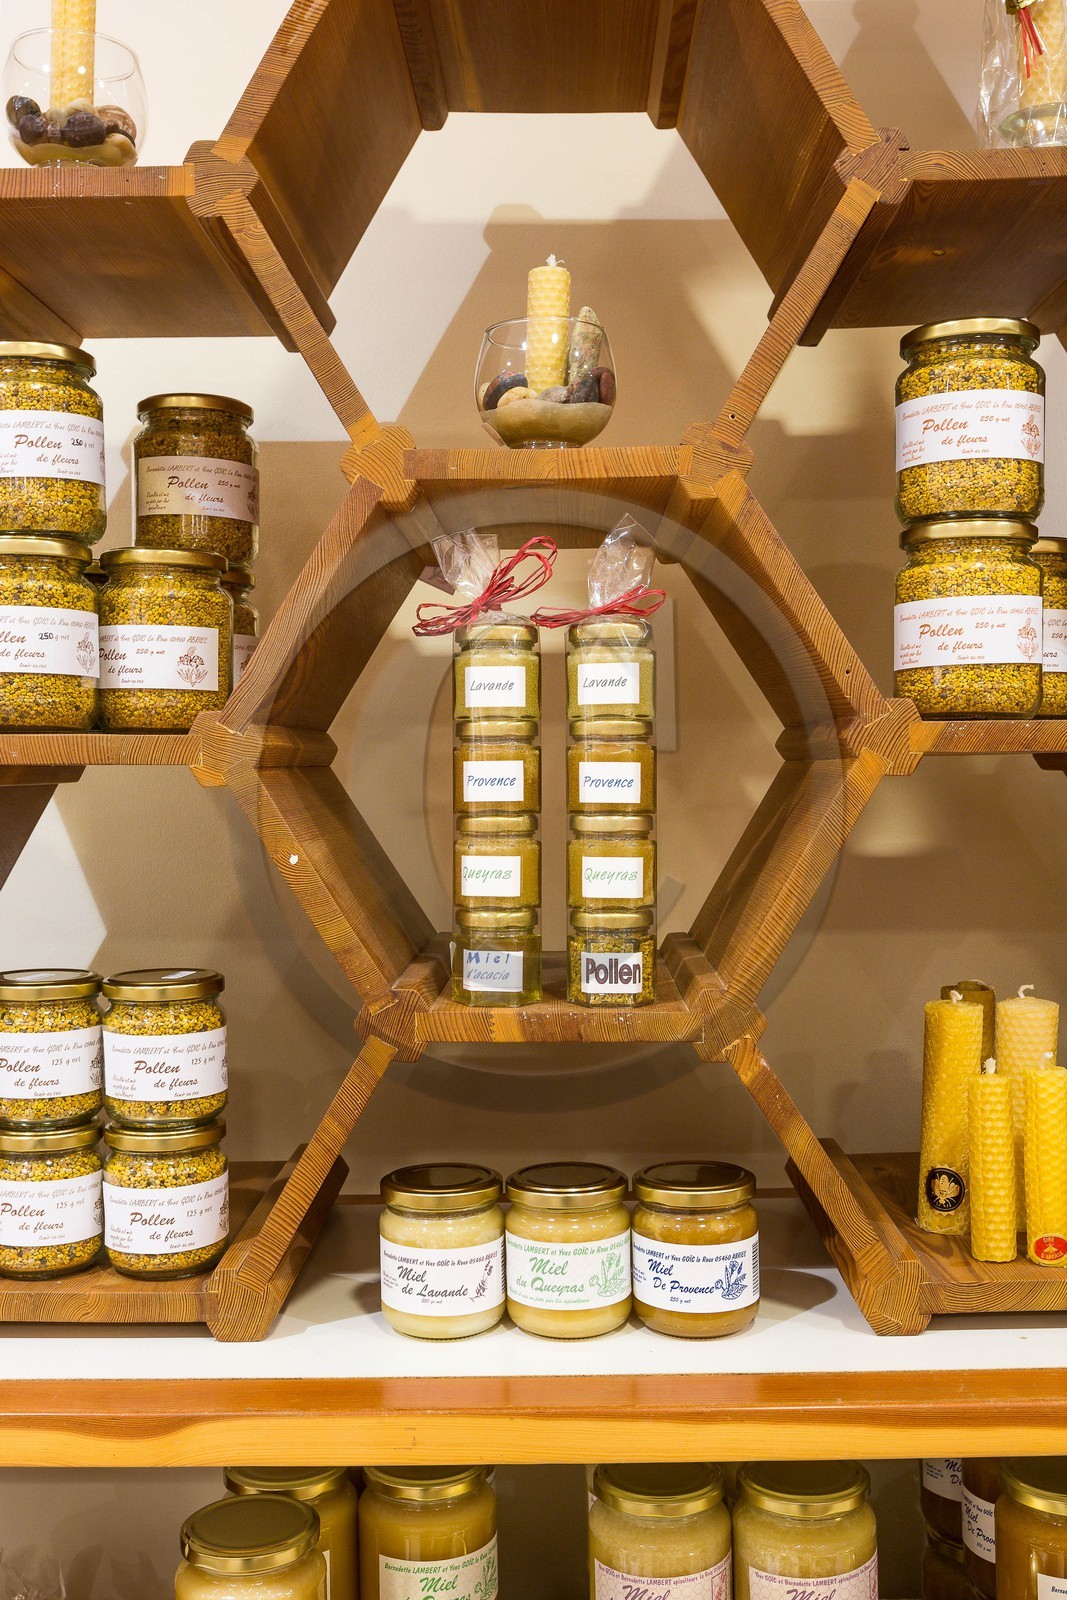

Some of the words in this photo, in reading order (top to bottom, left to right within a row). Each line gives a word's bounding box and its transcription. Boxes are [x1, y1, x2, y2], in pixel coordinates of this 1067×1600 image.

[922, 402, 953, 415] LAMBERT
[922, 418, 968, 435] Pollen
[14, 434, 62, 449] Pollen
[71, 438, 83, 446] 250
[941, 435, 952, 445] de
[956, 435, 988, 447] fleurs
[37, 454, 48, 462] de
[52, 455, 79, 465] fleurs
[167, 476, 209, 489] Pollen
[198, 494, 224, 503] fleurs
[918, 609, 947, 619] LAMBERT
[38, 632, 54, 640] 250
[918, 623, 964, 640] Pollen
[937, 642, 949, 651] de
[952, 641, 984, 653] fleurs
[0, 649, 11, 657] de
[14, 649, 46, 660] fleurs
[118, 665, 143, 676] fleurs
[470, 680, 514, 691] Lavande
[582, 676, 628, 688] Lavande
[467, 775, 517, 787] Provence
[583, 775, 634, 789] Provence
[463, 866, 513, 883] Queyras
[584, 867, 638, 884] Queyras
[466, 952, 510, 964] Miel
[467, 969, 510, 981] d'acacia
[585, 958, 641, 985] Pollen
[133, 1046, 165, 1055] LAMBERT
[133, 1060, 181, 1074] Pollen
[191, 1057, 201, 1066] 125
[14, 1078, 26, 1086] de
[29, 1078, 60, 1089] fleurs
[154, 1080, 166, 1088] de
[169, 1078, 198, 1090] fleurs
[0, 1202, 45, 1216] Pollen
[129, 1199, 160, 1207] LAMBERT
[130, 1212, 176, 1226] Pollen
[186, 1210, 197, 1218] 125
[205, 1205, 213, 1214] net
[19, 1222, 30, 1230] de
[33, 1222, 64, 1233] fleurs
[149, 1231, 161, 1240] de
[164, 1229, 194, 1242] fleurs
[523, 1245, 550, 1256] LAMBERT
[597, 1245, 609, 1253] Roux
[646, 1249, 665, 1259] LAMBERT
[715, 1254, 732, 1262] 05460
[732, 1250, 747, 1259] ABRIES
[397, 1256, 419, 1265] LAMBERT
[425, 1259, 435, 1267] Yves
[469, 1256, 485, 1265] 05460
[529, 1256, 569, 1276] Miel
[648, 1258, 674, 1276] Miel
[397, 1265, 427, 1283] Miel
[402, 1283, 413, 1295] de
[416, 1284, 469, 1298] Lavande
[516, 1275, 526, 1288] du
[530, 1276, 585, 1296] Queyras
[653, 1277, 667, 1290] De
[669, 1280, 715, 1294] Provence
[965, 1504, 978, 1523] Miel
[968, 1521, 975, 1534] De
[384, 1563, 411, 1573] Bernadette
[412, 1566, 441, 1574] LAMBERT
[449, 1564, 460, 1572] Yves
[420, 1575, 458, 1593] Miel
[621, 1574, 645, 1584] Bernadette
[673, 1576, 698, 1586] apiculteurs
[812, 1578, 838, 1586] LAMBERT
[622, 1585, 670, 1600] Miel
[787, 1588, 836, 1600] Miel
